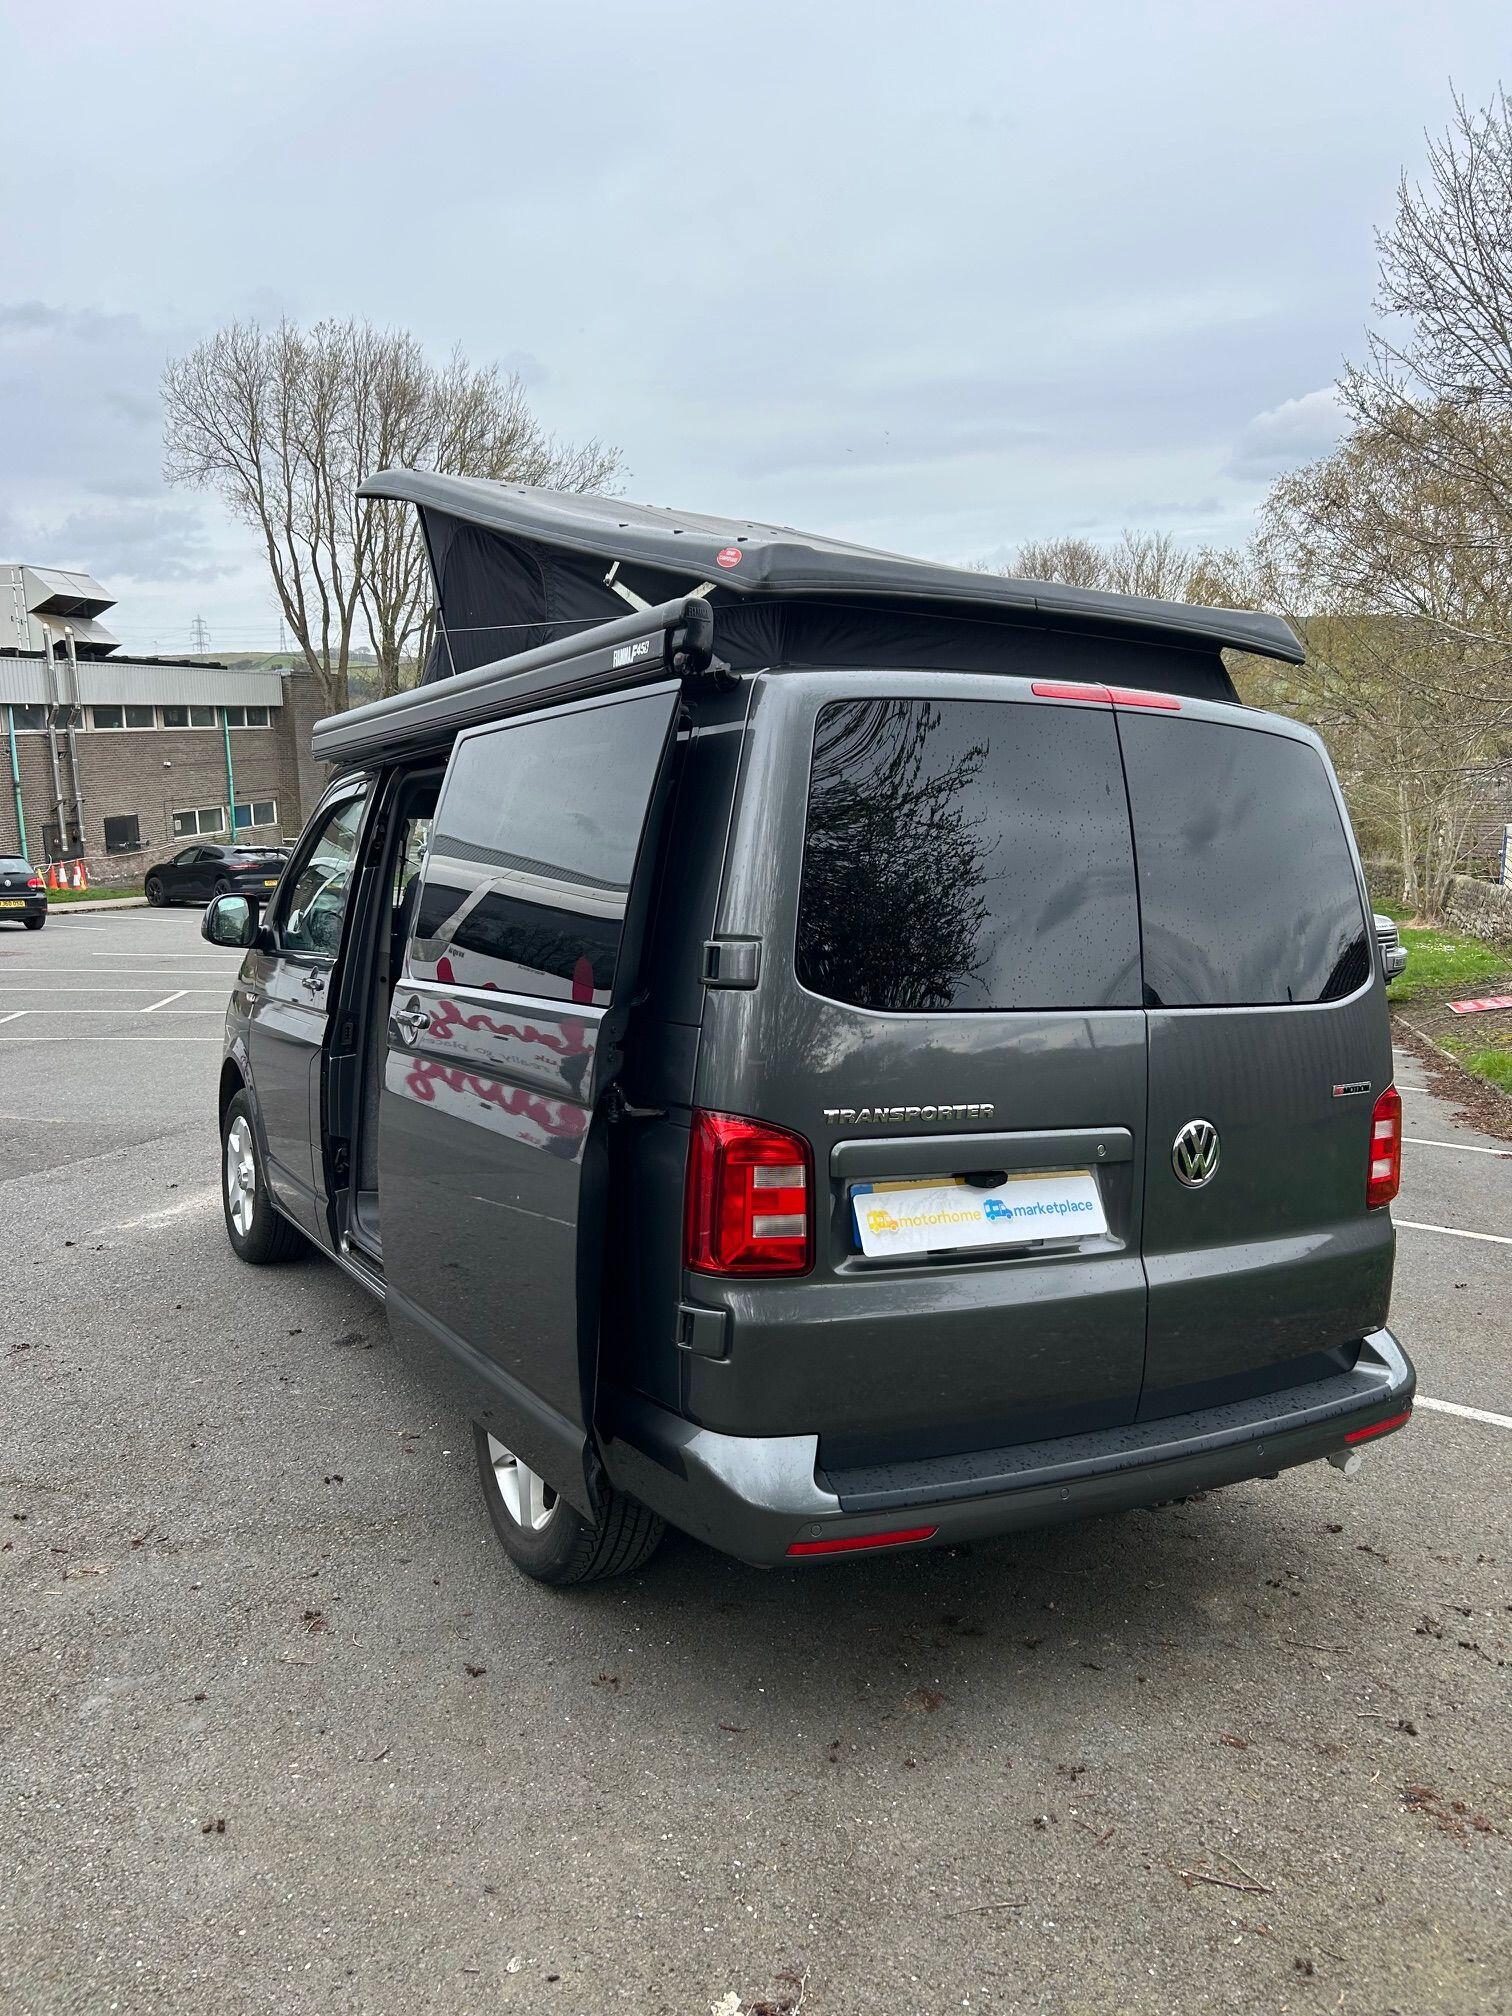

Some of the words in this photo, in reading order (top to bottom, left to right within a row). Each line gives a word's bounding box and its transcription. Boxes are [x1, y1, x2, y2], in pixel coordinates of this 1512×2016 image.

[823, 1103, 995, 1125] TRANSPORTER
[898, 1209, 983, 1229] motorhome
[1013, 1199, 1094, 1217] marketplace
